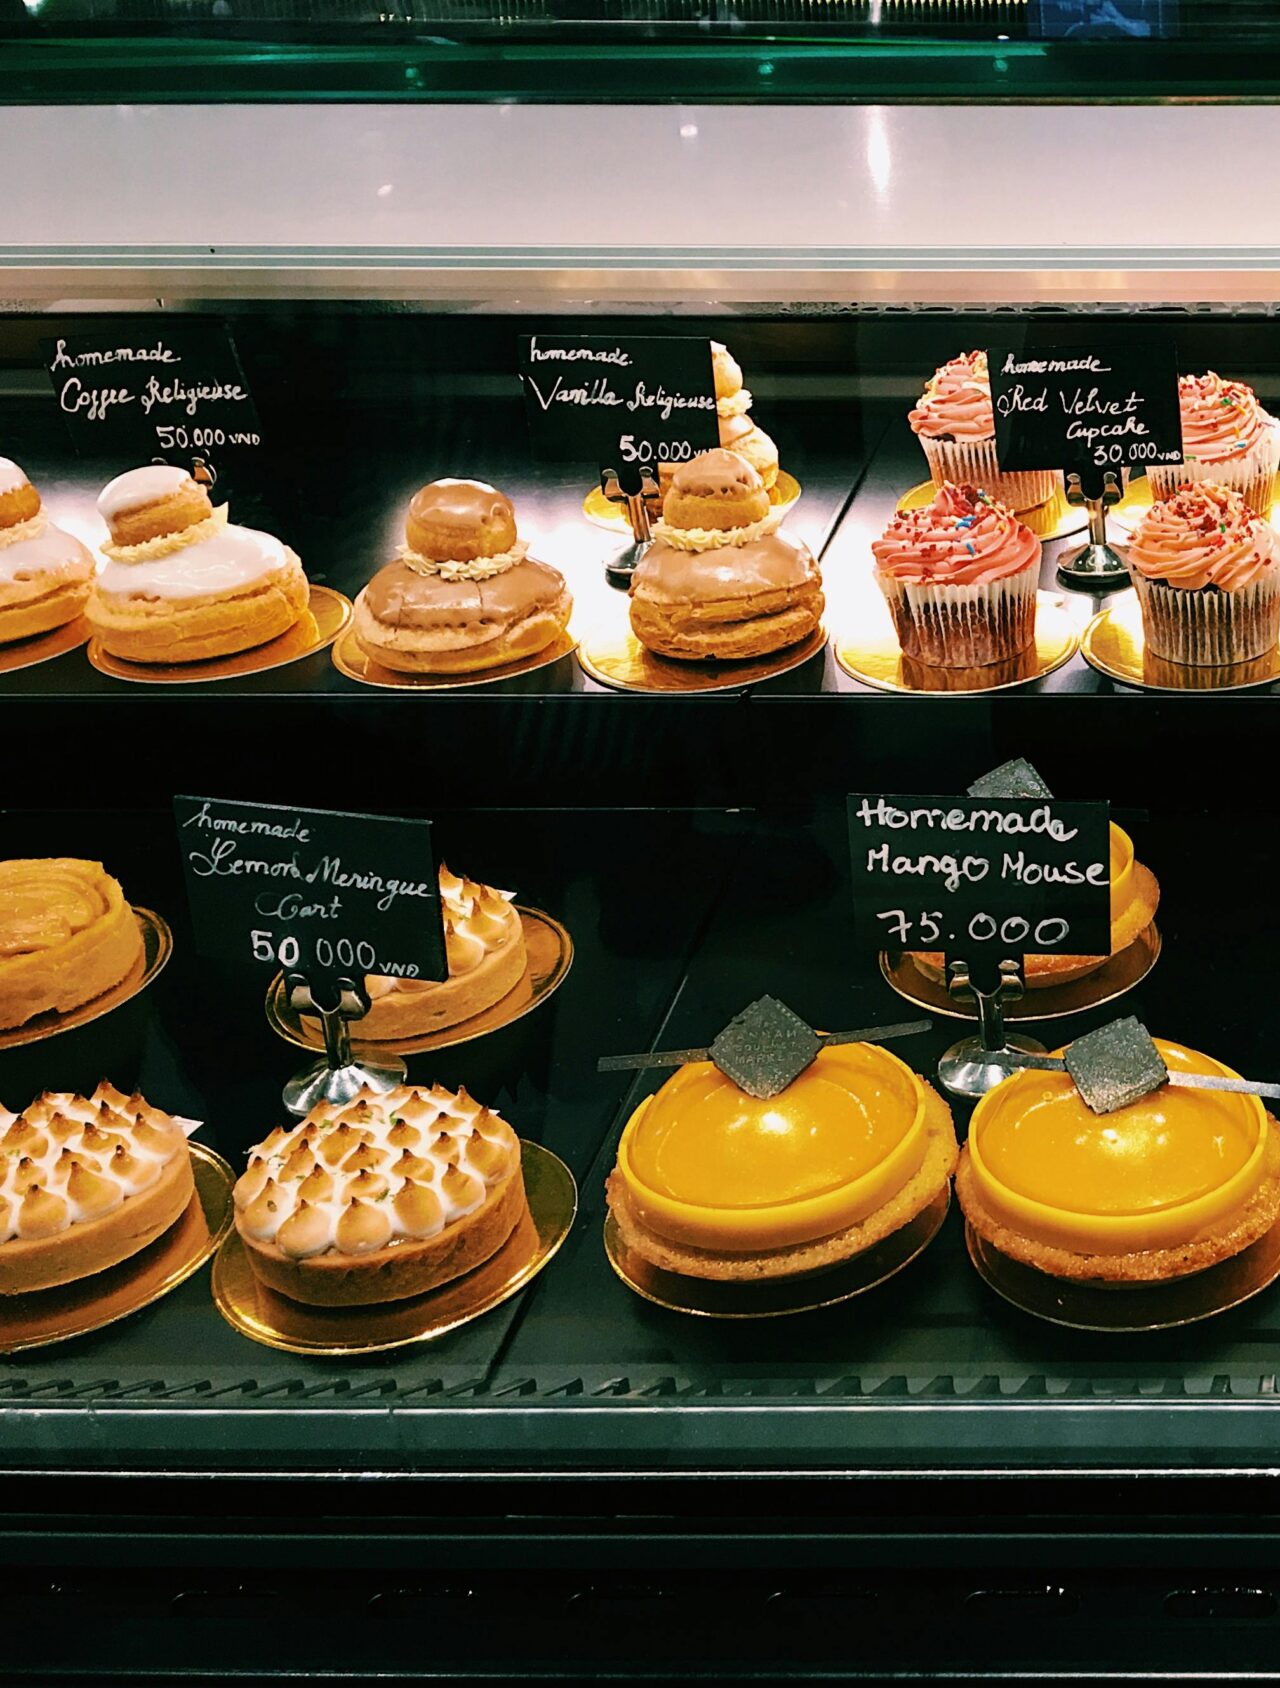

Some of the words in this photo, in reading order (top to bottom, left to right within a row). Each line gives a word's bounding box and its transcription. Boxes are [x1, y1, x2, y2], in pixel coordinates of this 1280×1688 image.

[50, 339, 181, 371] homemade
[1001, 353, 1111, 375] homemade
[141, 375, 248, 415] Religieuse
[527, 375, 624, 410] Vanilla
[626, 381, 716, 420] Religieuse
[997, 384, 1048, 417] Red
[1060, 387, 1144, 415] Velvet
[1066, 416, 1149, 448] Cupcake
[182, 802, 310, 843] homemade
[856, 798, 1078, 842] Homemade
[305, 856, 435, 911] Meringue
[867, 844, 990, 893] Mango
[1001, 851, 1110, 886] Mouse
[876, 910, 1070, 945] 75.000
